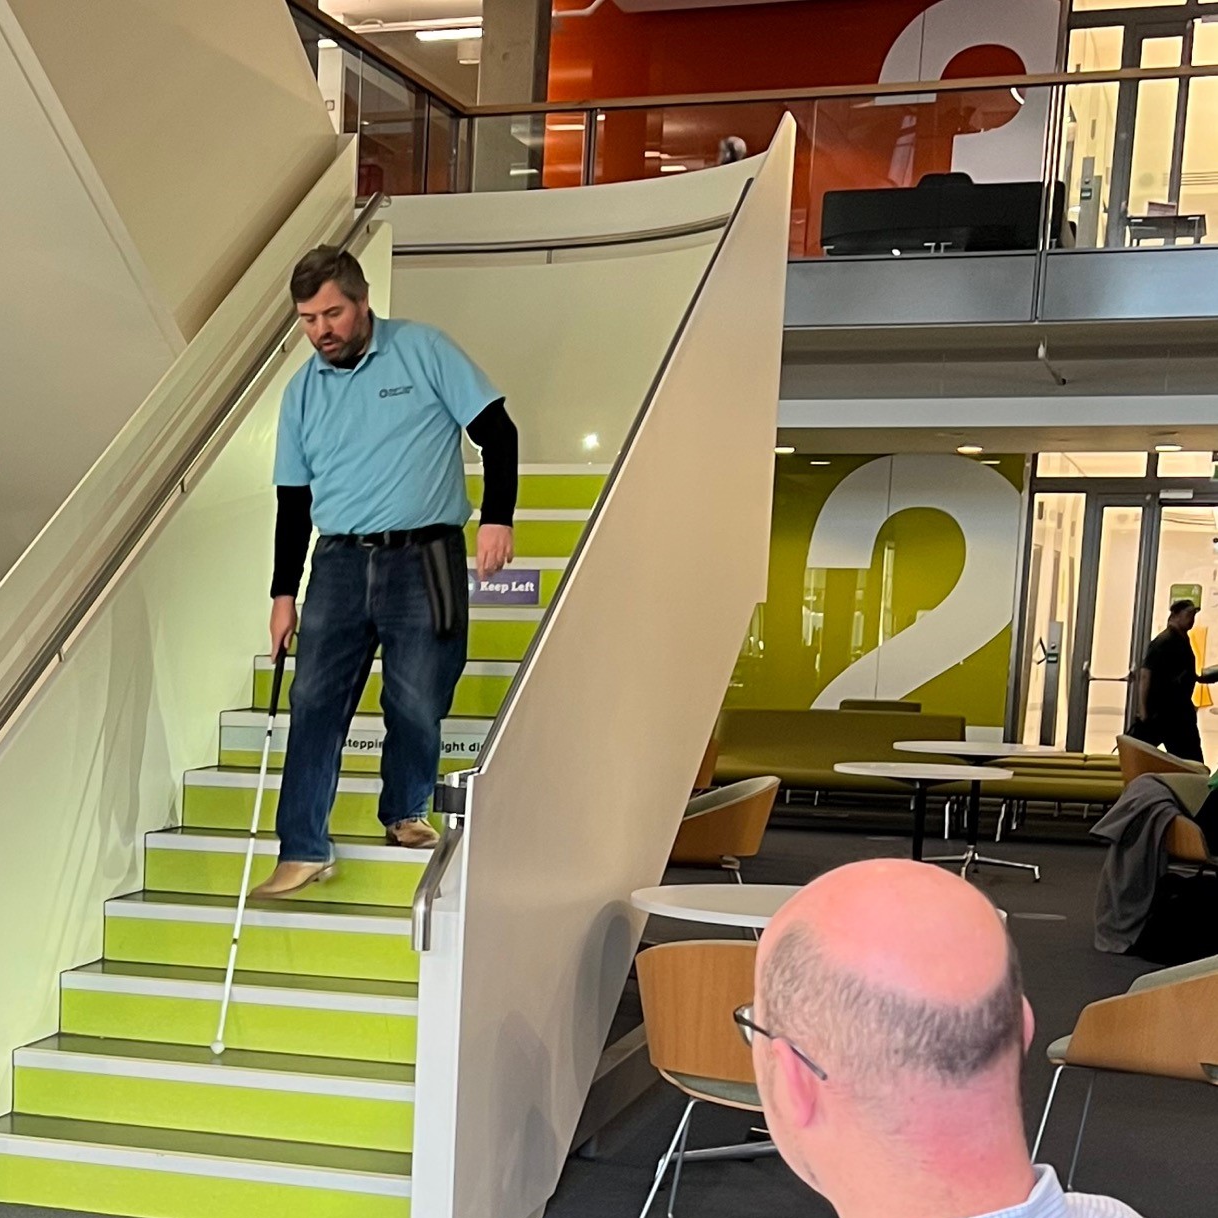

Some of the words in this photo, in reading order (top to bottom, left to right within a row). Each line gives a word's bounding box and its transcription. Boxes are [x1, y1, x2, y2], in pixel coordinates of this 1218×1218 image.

[480, 581, 509, 594] Keep
[511, 581, 535, 592] Left
[806, 453, 1022, 710] 2
